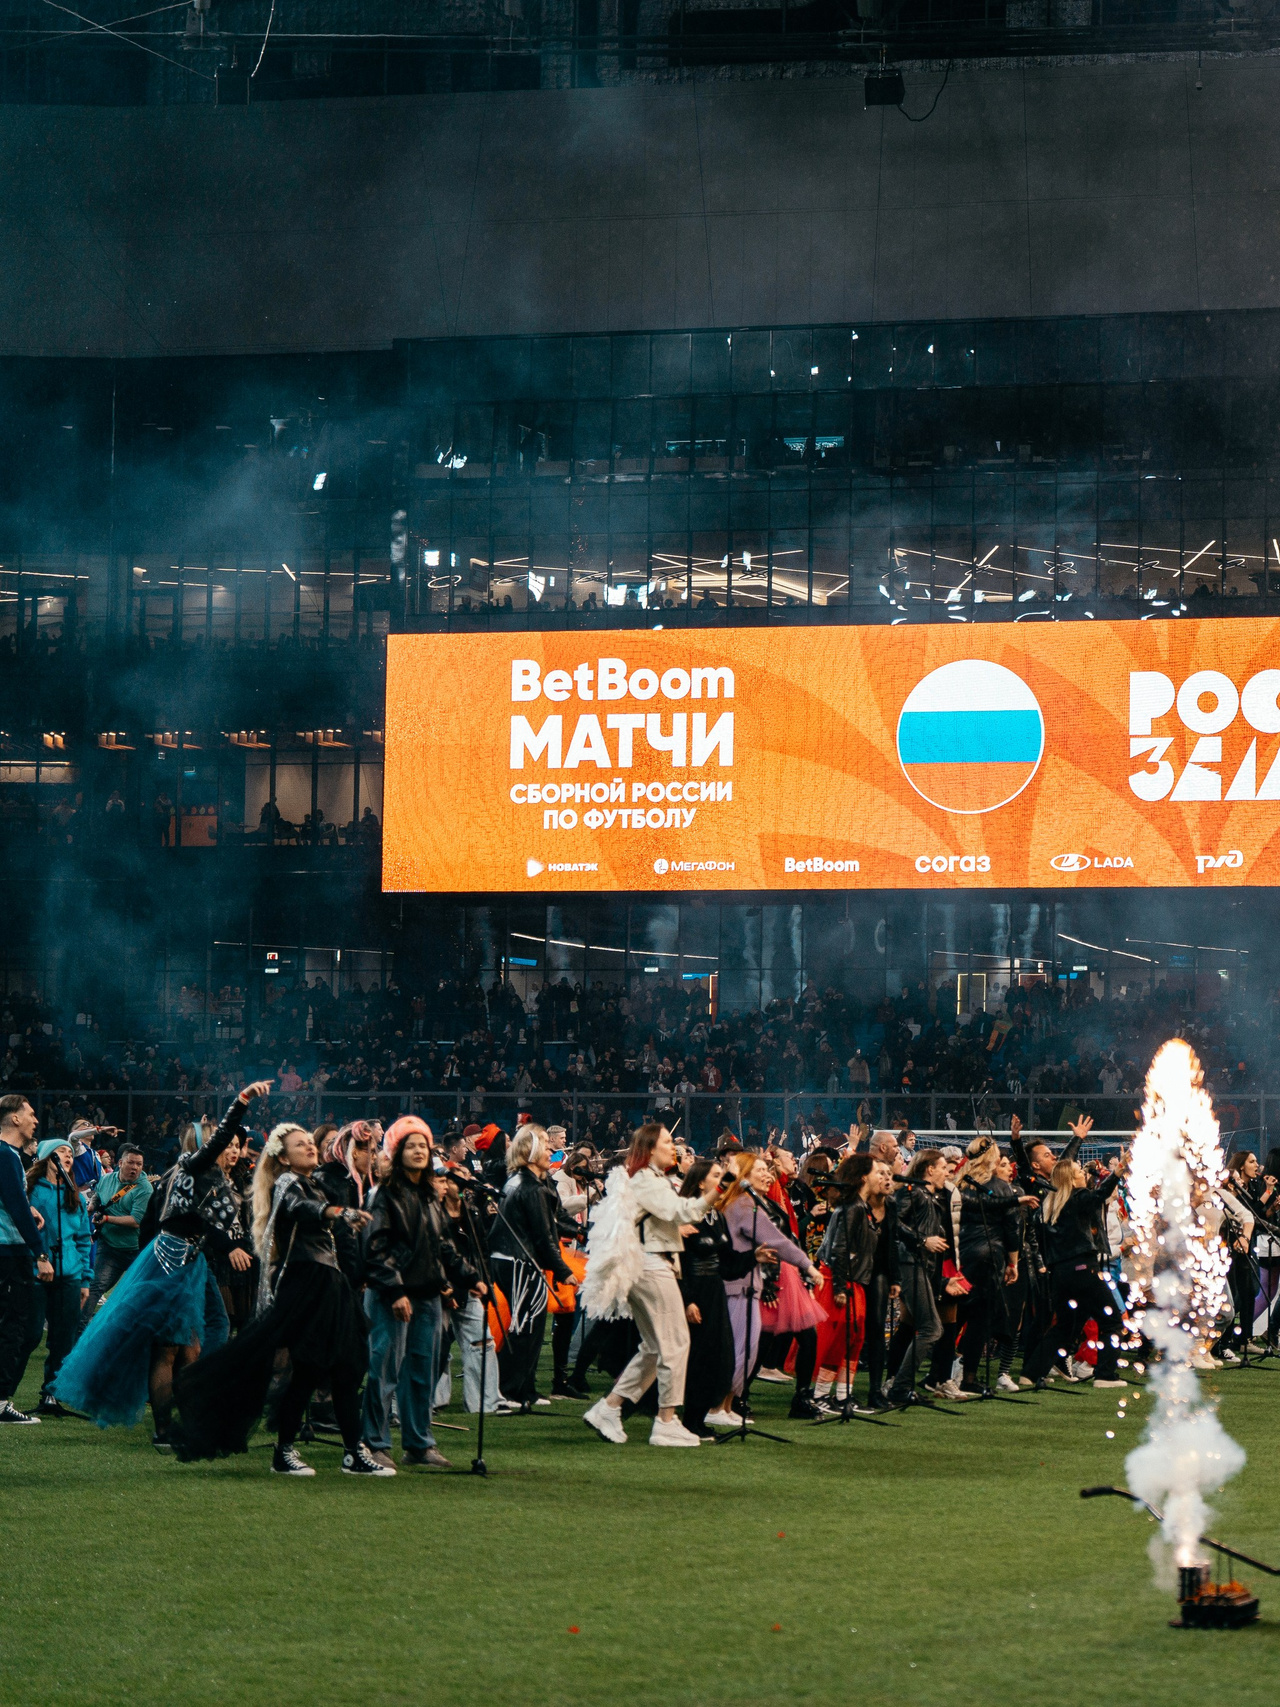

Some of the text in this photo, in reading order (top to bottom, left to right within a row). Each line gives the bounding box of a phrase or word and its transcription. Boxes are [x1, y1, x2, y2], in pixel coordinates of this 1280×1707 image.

[511, 657, 735, 702] BetBoom
[510, 711, 735, 769] МАТЧИ
[509, 777, 733, 804] СБОРНОЙ РОССИИ
[543, 808, 697, 830] ПО ФУТБОЛУ
[548, 862, 599, 872] НОВАТЭК
[784, 857, 860, 873] BetBoom
[1094, 856, 1135, 869] LADA
